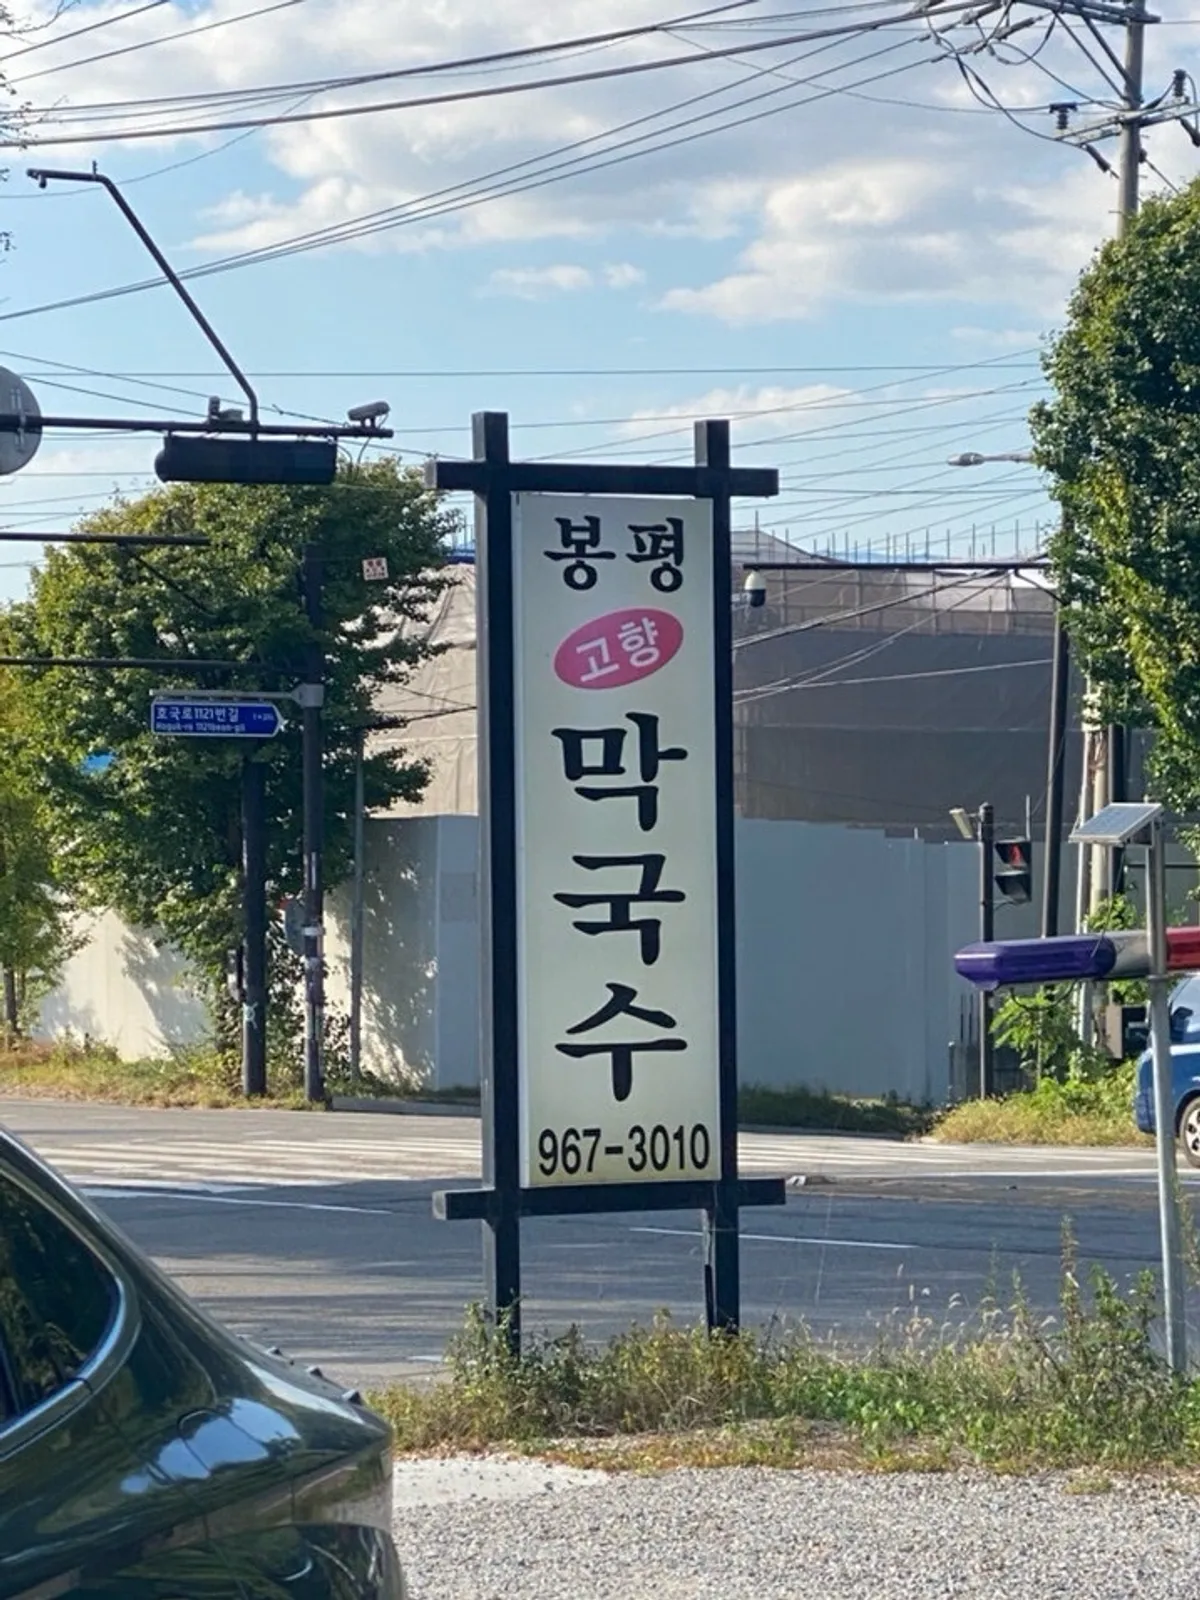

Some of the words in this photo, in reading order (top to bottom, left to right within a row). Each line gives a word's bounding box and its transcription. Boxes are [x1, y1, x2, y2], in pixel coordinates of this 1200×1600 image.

[543, 515, 684, 593] 봉평
[575, 616, 660, 682] 고향
[551, 711, 688, 1101] 막국수
[538, 1123, 710, 1176] 967-3010
